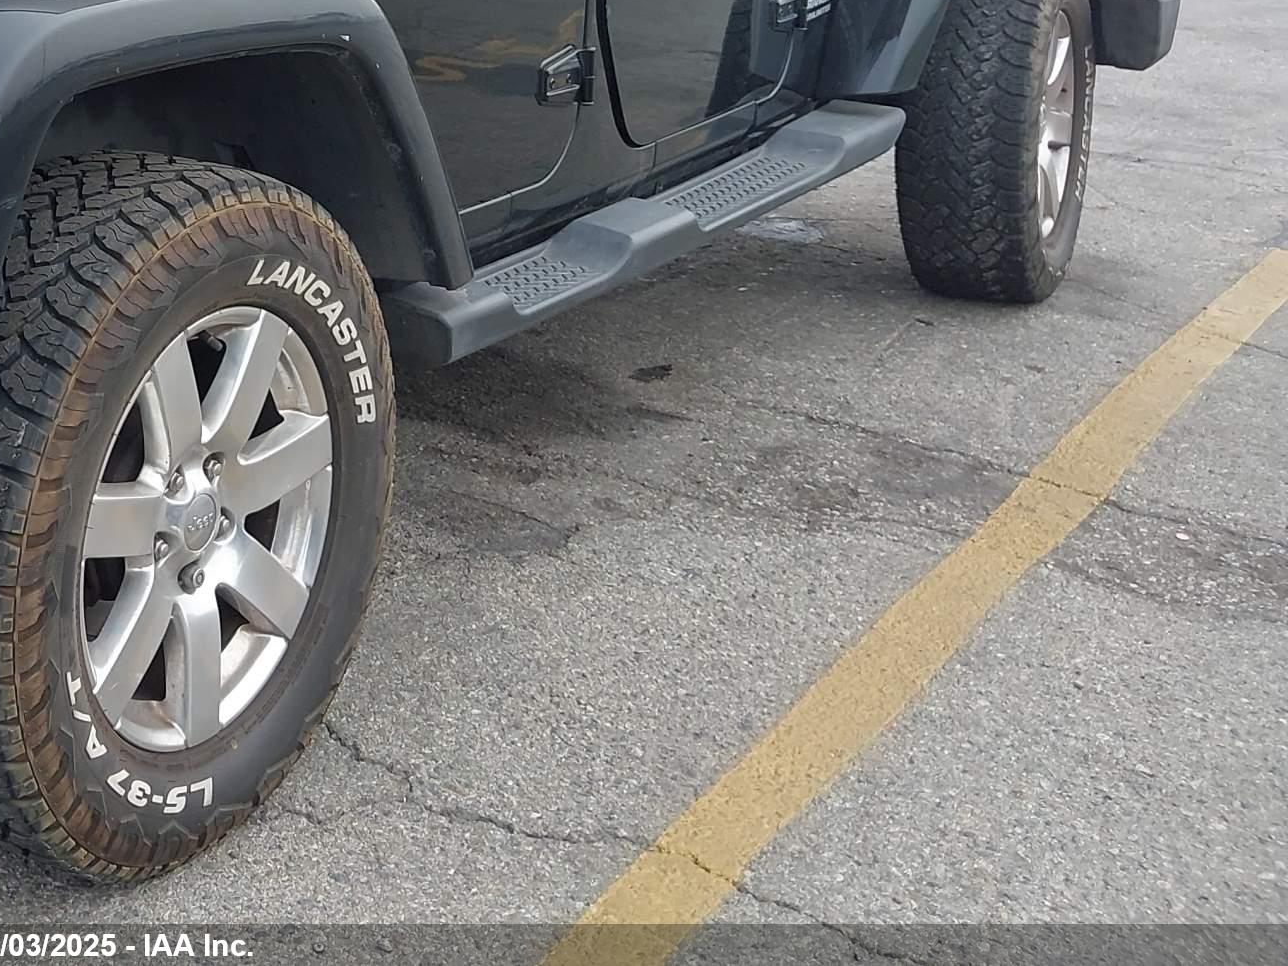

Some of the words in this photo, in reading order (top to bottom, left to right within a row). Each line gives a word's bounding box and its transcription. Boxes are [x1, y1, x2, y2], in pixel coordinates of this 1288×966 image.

[247, 259, 378, 424] LANCASTER
[66, 671, 108, 760] A/T
[106, 769, 213, 814] LS-37
